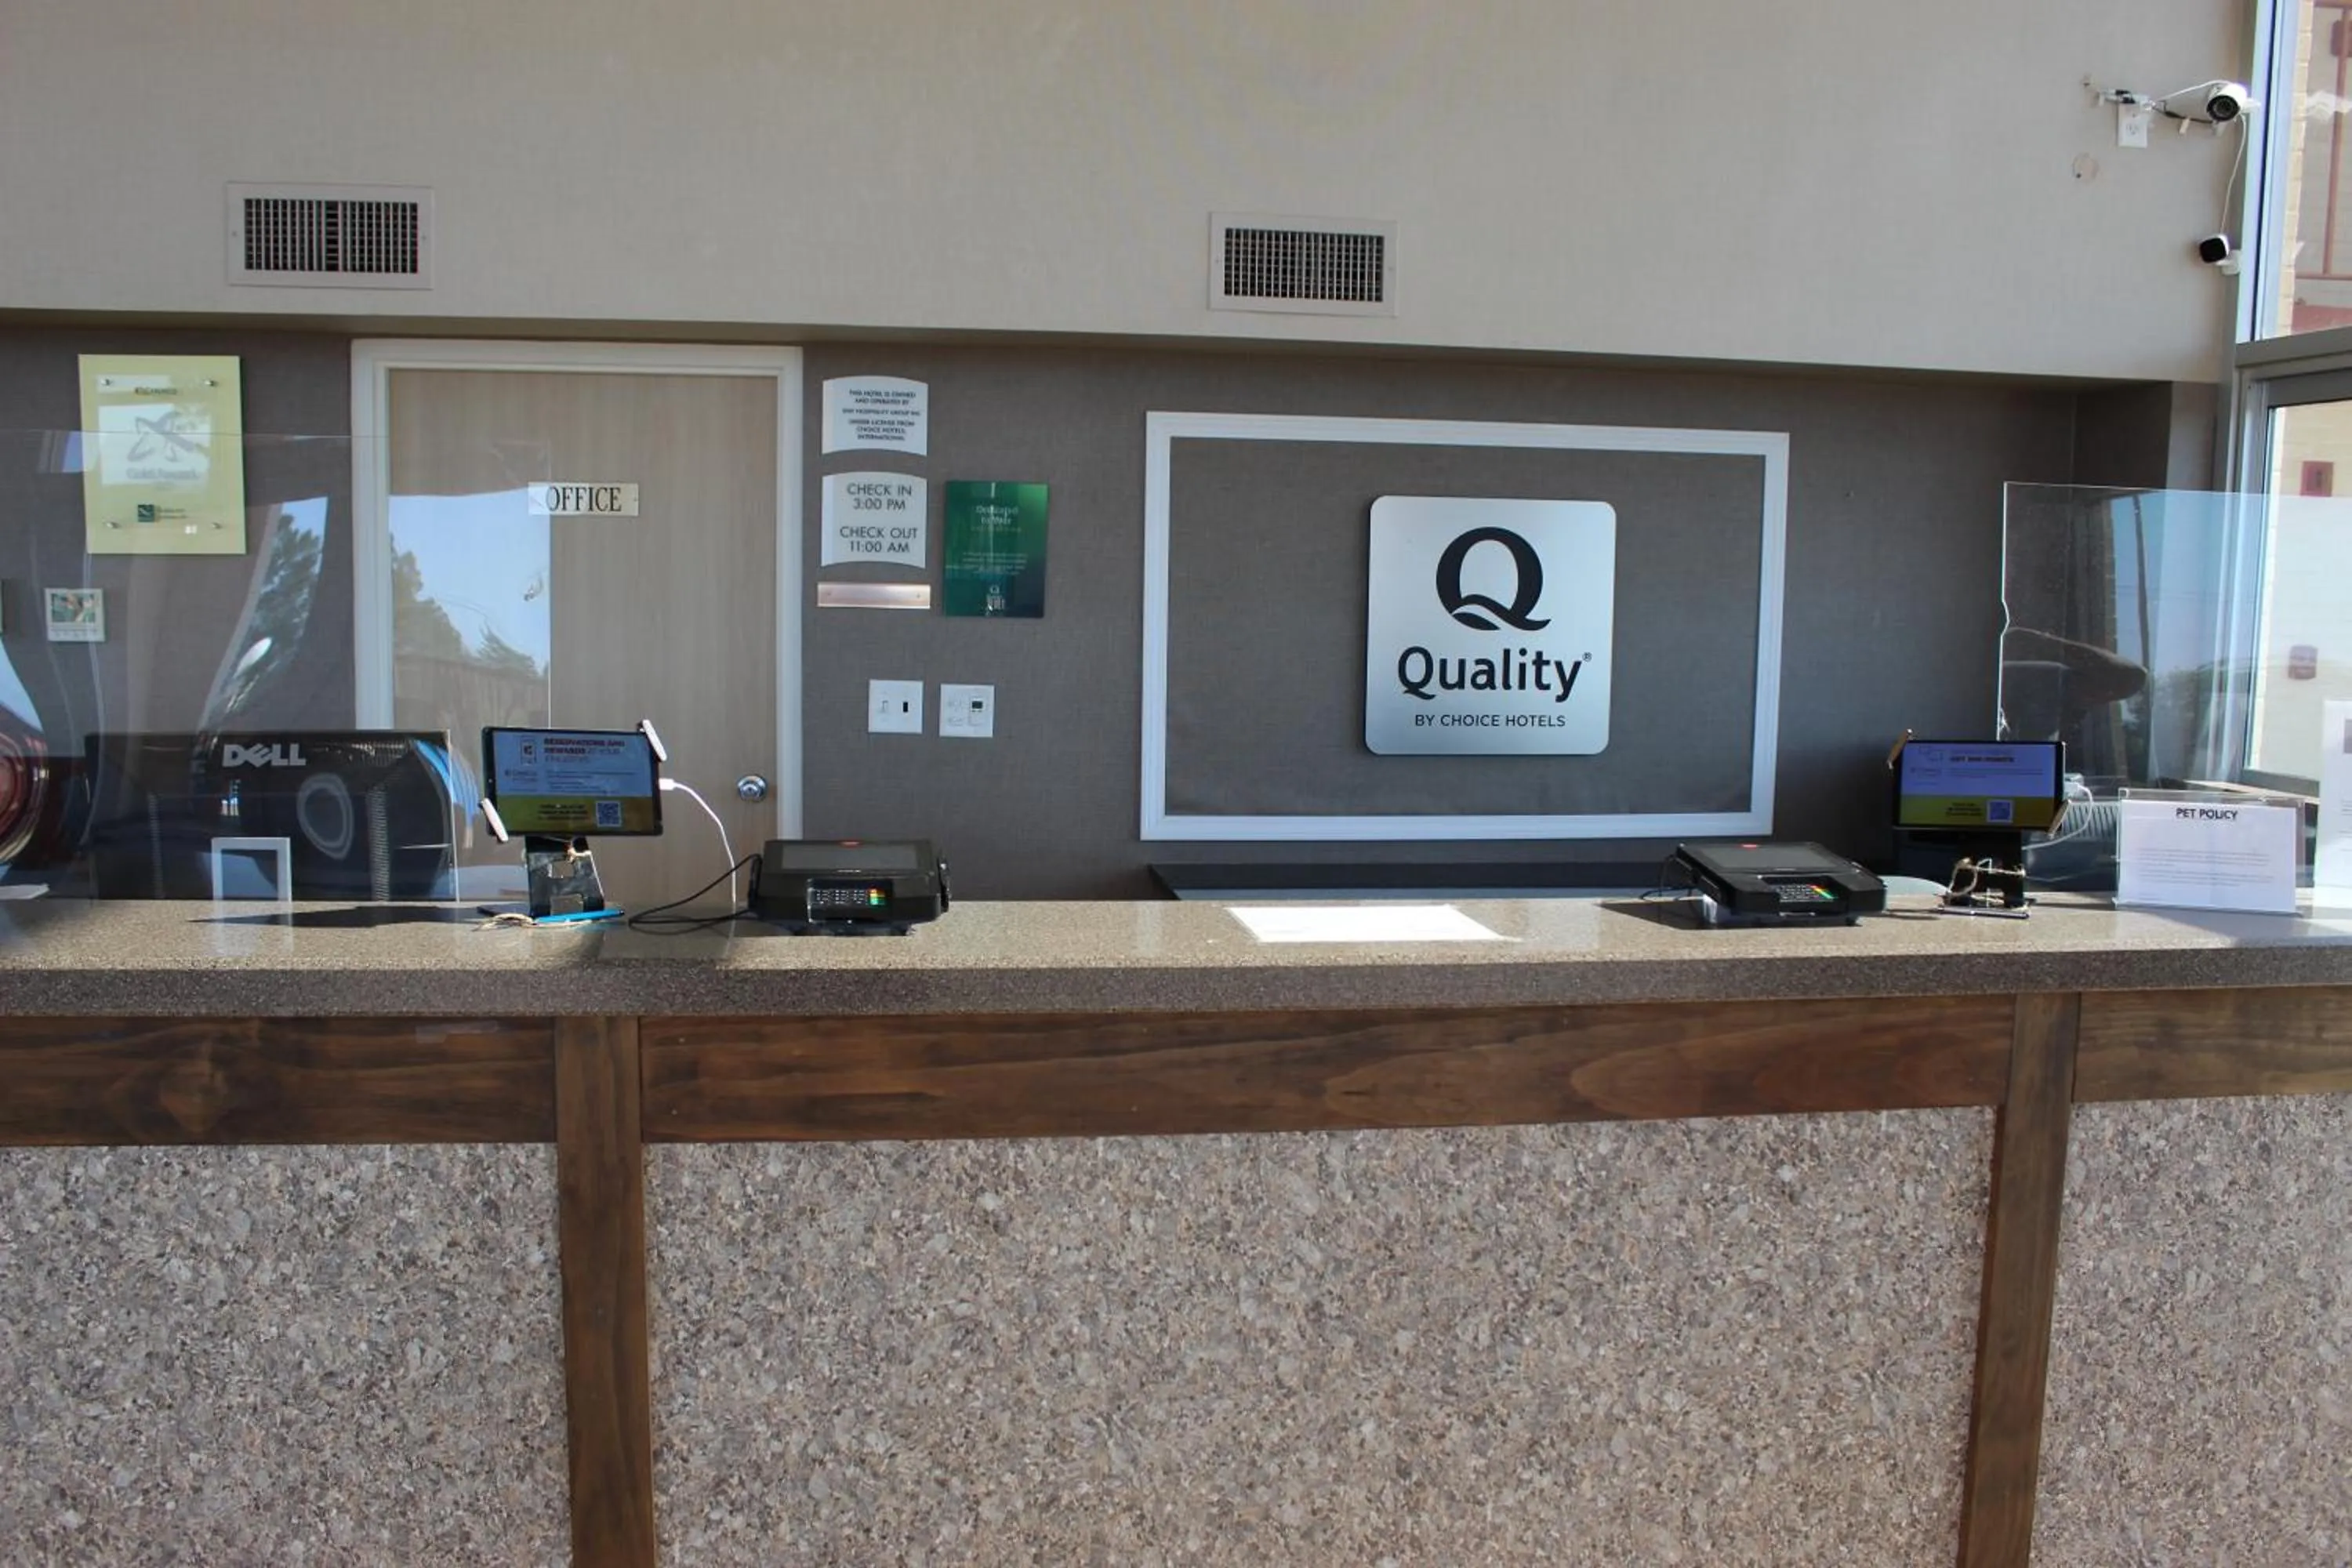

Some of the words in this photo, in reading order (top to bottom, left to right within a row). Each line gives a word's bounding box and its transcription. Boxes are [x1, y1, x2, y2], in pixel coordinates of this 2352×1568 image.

[847, 483, 891, 496] CHECK
[898, 485, 912, 496] IN
[546, 486, 622, 511] OFFICE
[853, 497, 882, 510] 3:00
[887, 498, 906, 510] PM
[840, 526, 884, 538] CHECK
[890, 526, 917, 539] OUT
[851, 540, 882, 552] 11:00
[887, 541, 909, 553] AM
[1398, 645, 1582, 703] Quality
[1415, 714, 1436, 727] BY
[1440, 714, 1501, 727] CHOICE
[1505, 714, 1566, 728] HOTELS
[222, 743, 307, 768] DELL
[2176, 808, 2196, 819] PET
[2199, 808, 2238, 821] POLICY
